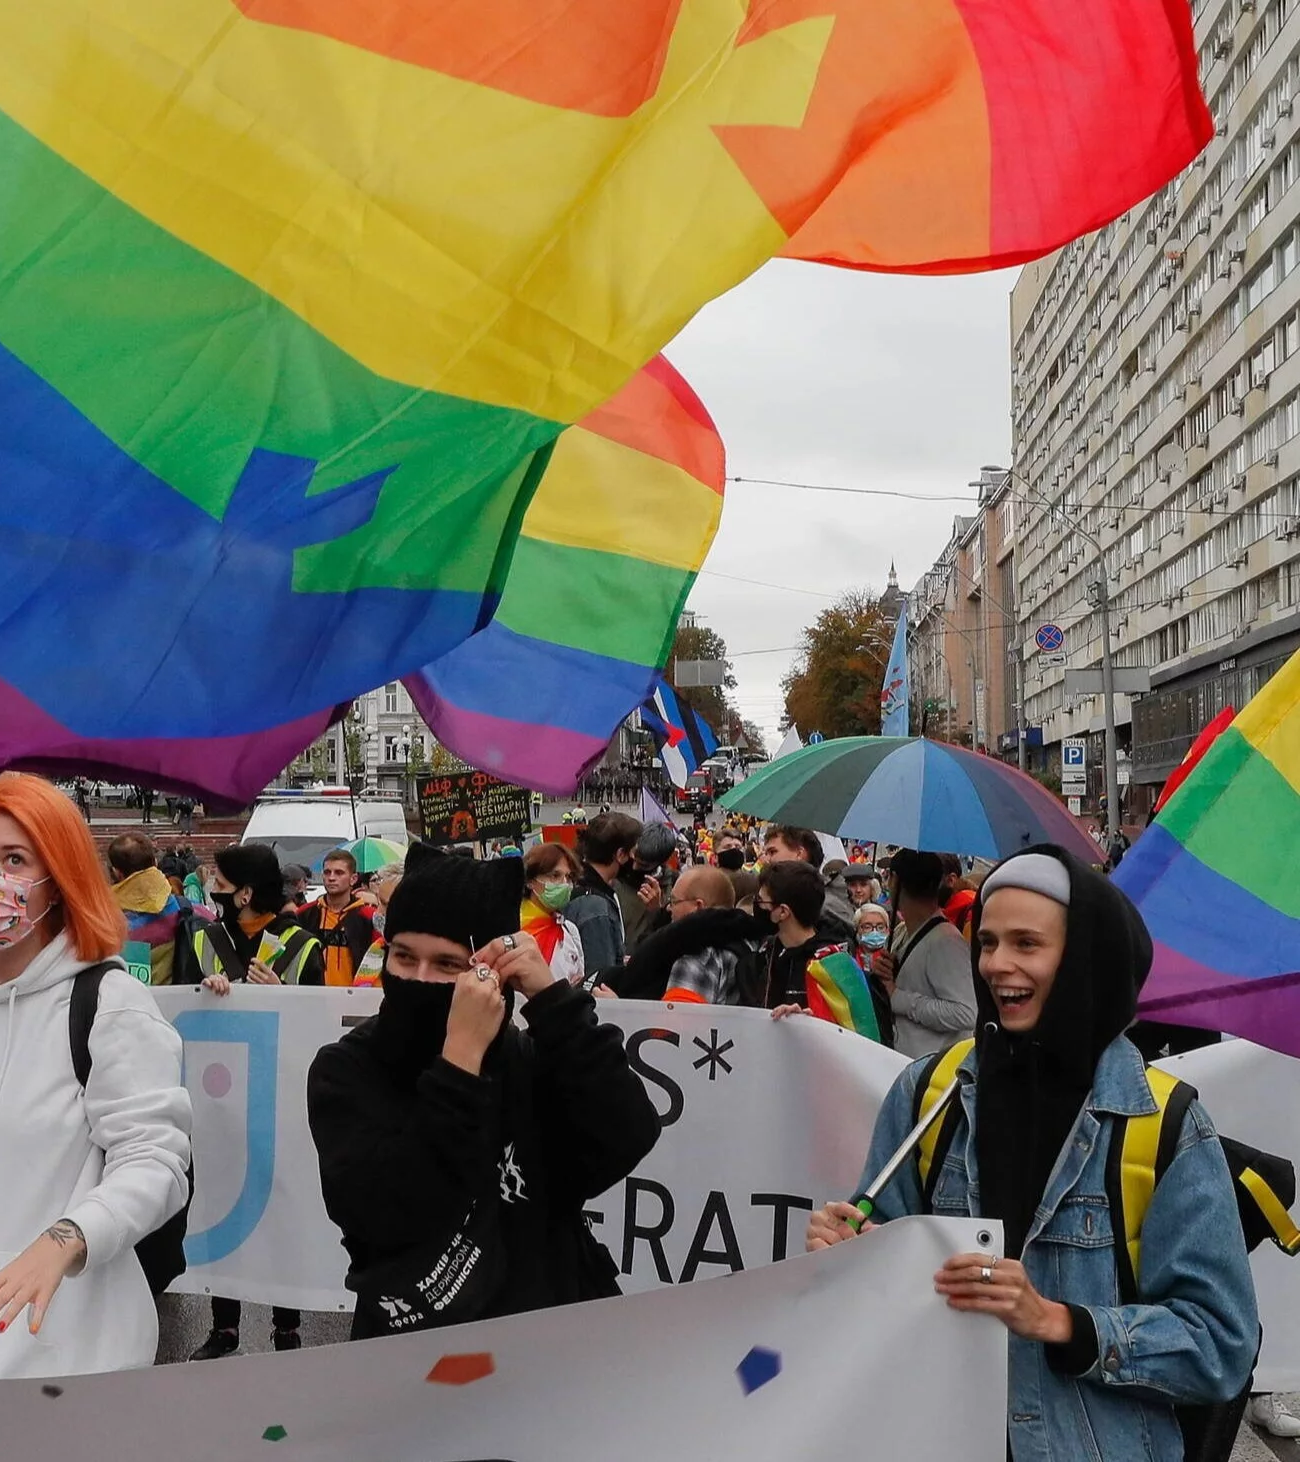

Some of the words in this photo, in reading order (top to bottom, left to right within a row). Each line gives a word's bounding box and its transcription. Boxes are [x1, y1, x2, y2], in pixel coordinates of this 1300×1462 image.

[475, 796, 525, 817] НЕБІНАРНІ
[416, 1253, 449, 1292] ХАРКІВ
[425, 1244, 470, 1303] ДЕРЖПРОМ
[433, 1246, 481, 1311] ФЕМІНІСТКИ
[389, 1312, 424, 1328] сфера
